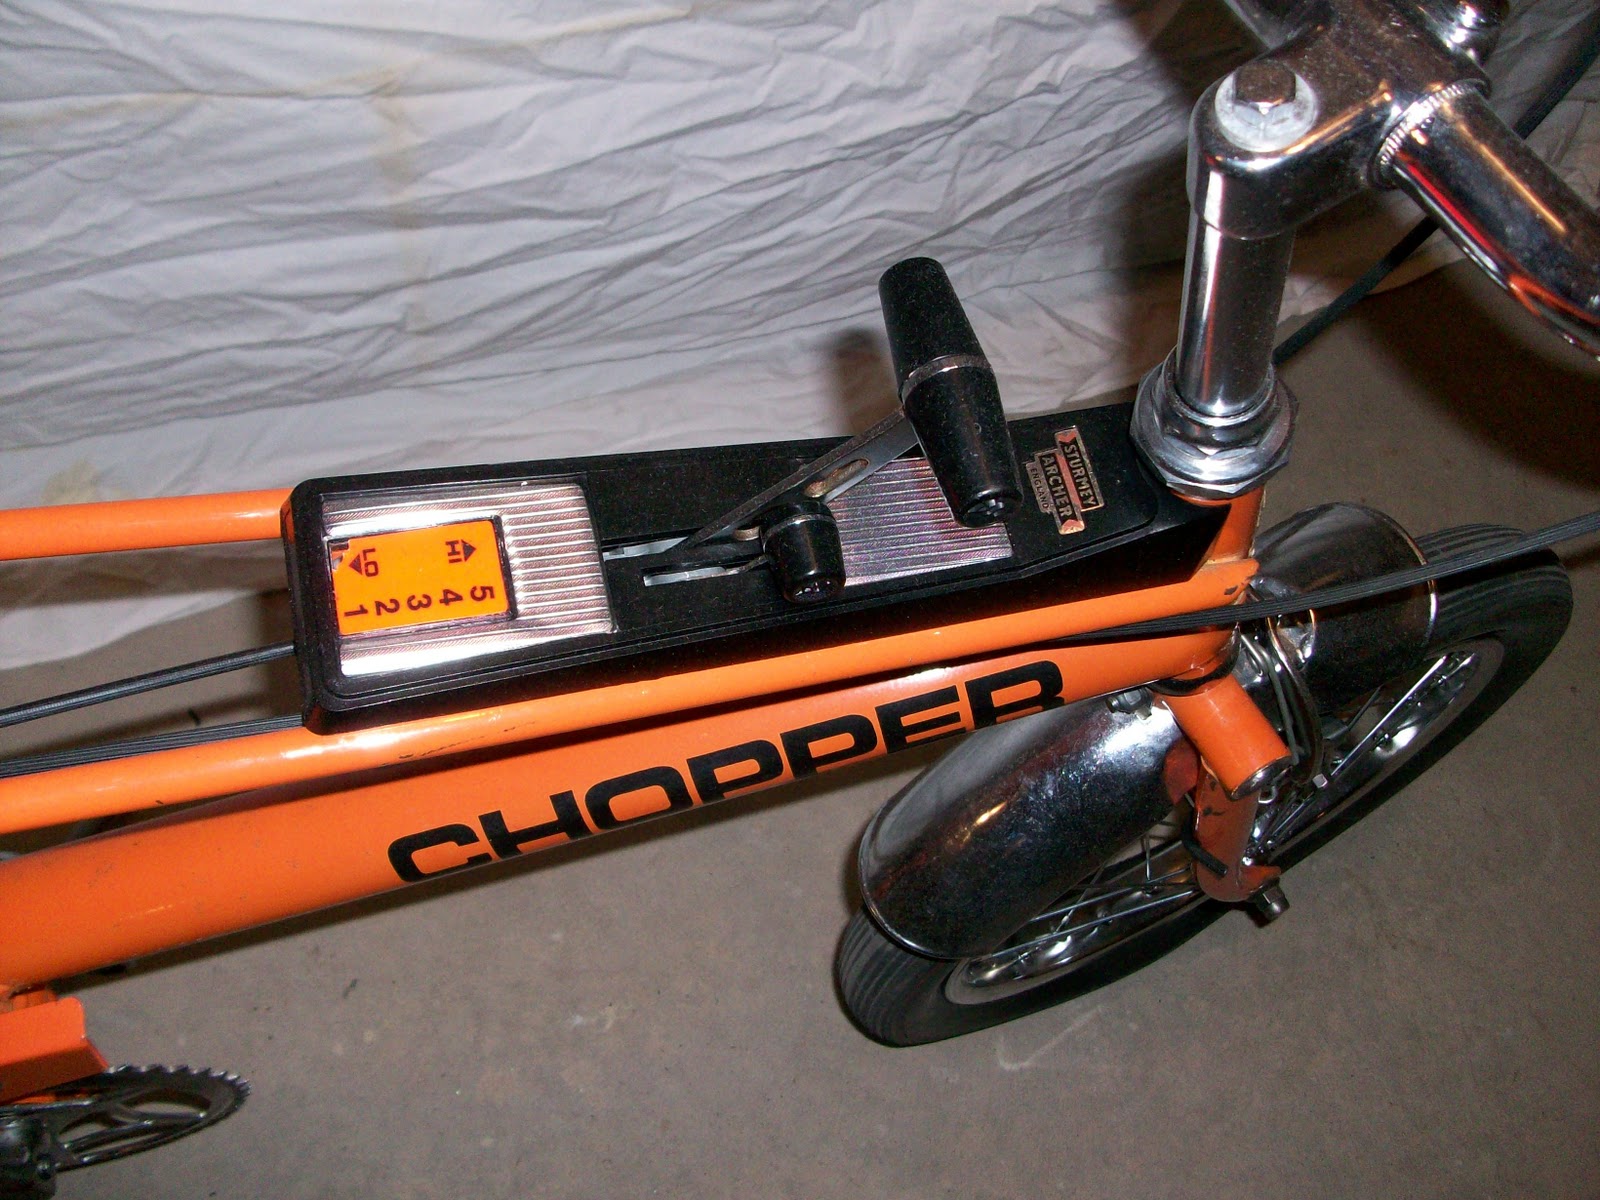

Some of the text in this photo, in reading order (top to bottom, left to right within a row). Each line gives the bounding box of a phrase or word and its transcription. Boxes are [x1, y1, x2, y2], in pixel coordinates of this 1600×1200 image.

[1042, 456, 1072, 517] ARCHER
[1064, 444, 1097, 506] STURMEY
[1030, 468, 1049, 509] ENGLAND
[362, 548, 379, 577] LO
[445, 540, 463, 563] HI
[407, 594, 432, 609] 3
[439, 588, 463, 605] 4
[470, 585, 494, 601] 5
[344, 604, 367, 616] 1
[375, 599, 400, 616] 2
[388, 660, 1064, 882] CHOPPER
